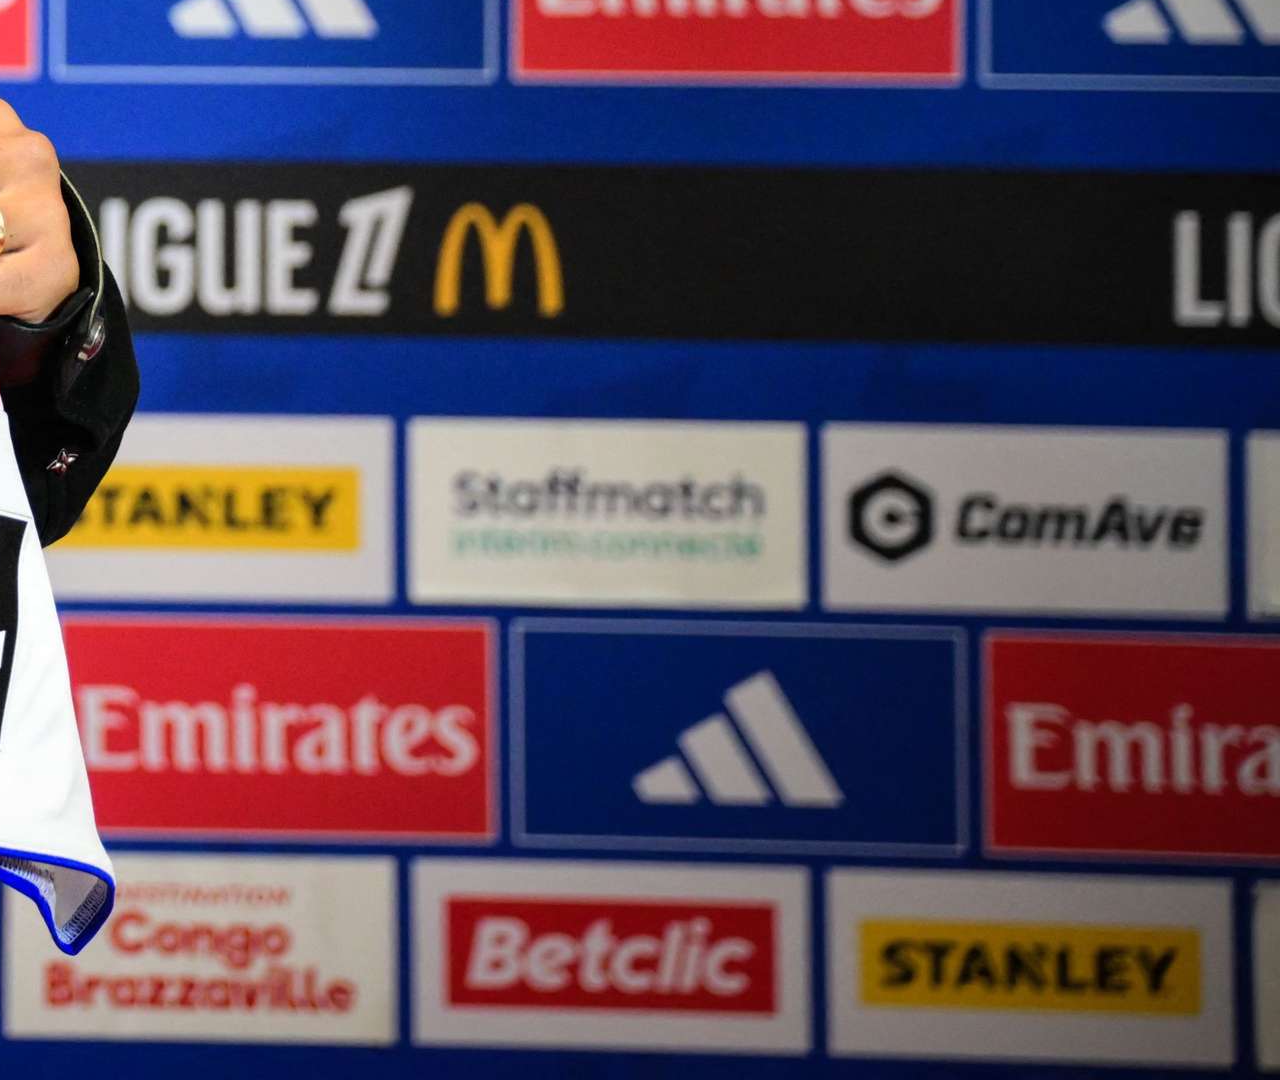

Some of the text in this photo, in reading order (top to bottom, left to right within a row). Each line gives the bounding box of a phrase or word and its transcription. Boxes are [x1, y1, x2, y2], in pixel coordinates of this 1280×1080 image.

[99, 196, 318, 315] IGUE
[82, 485, 333, 531] TANLEY
[454, 469, 768, 520] Staffmatch
[954, 494, 1205, 550] ComAve
[78, 684, 479, 776] Emirates
[109, 911, 291, 971] Congo
[465, 916, 752, 995] Betclic
[880, 941, 1178, 996] STANLEY
[44, 961, 355, 1010] Brazzaville
